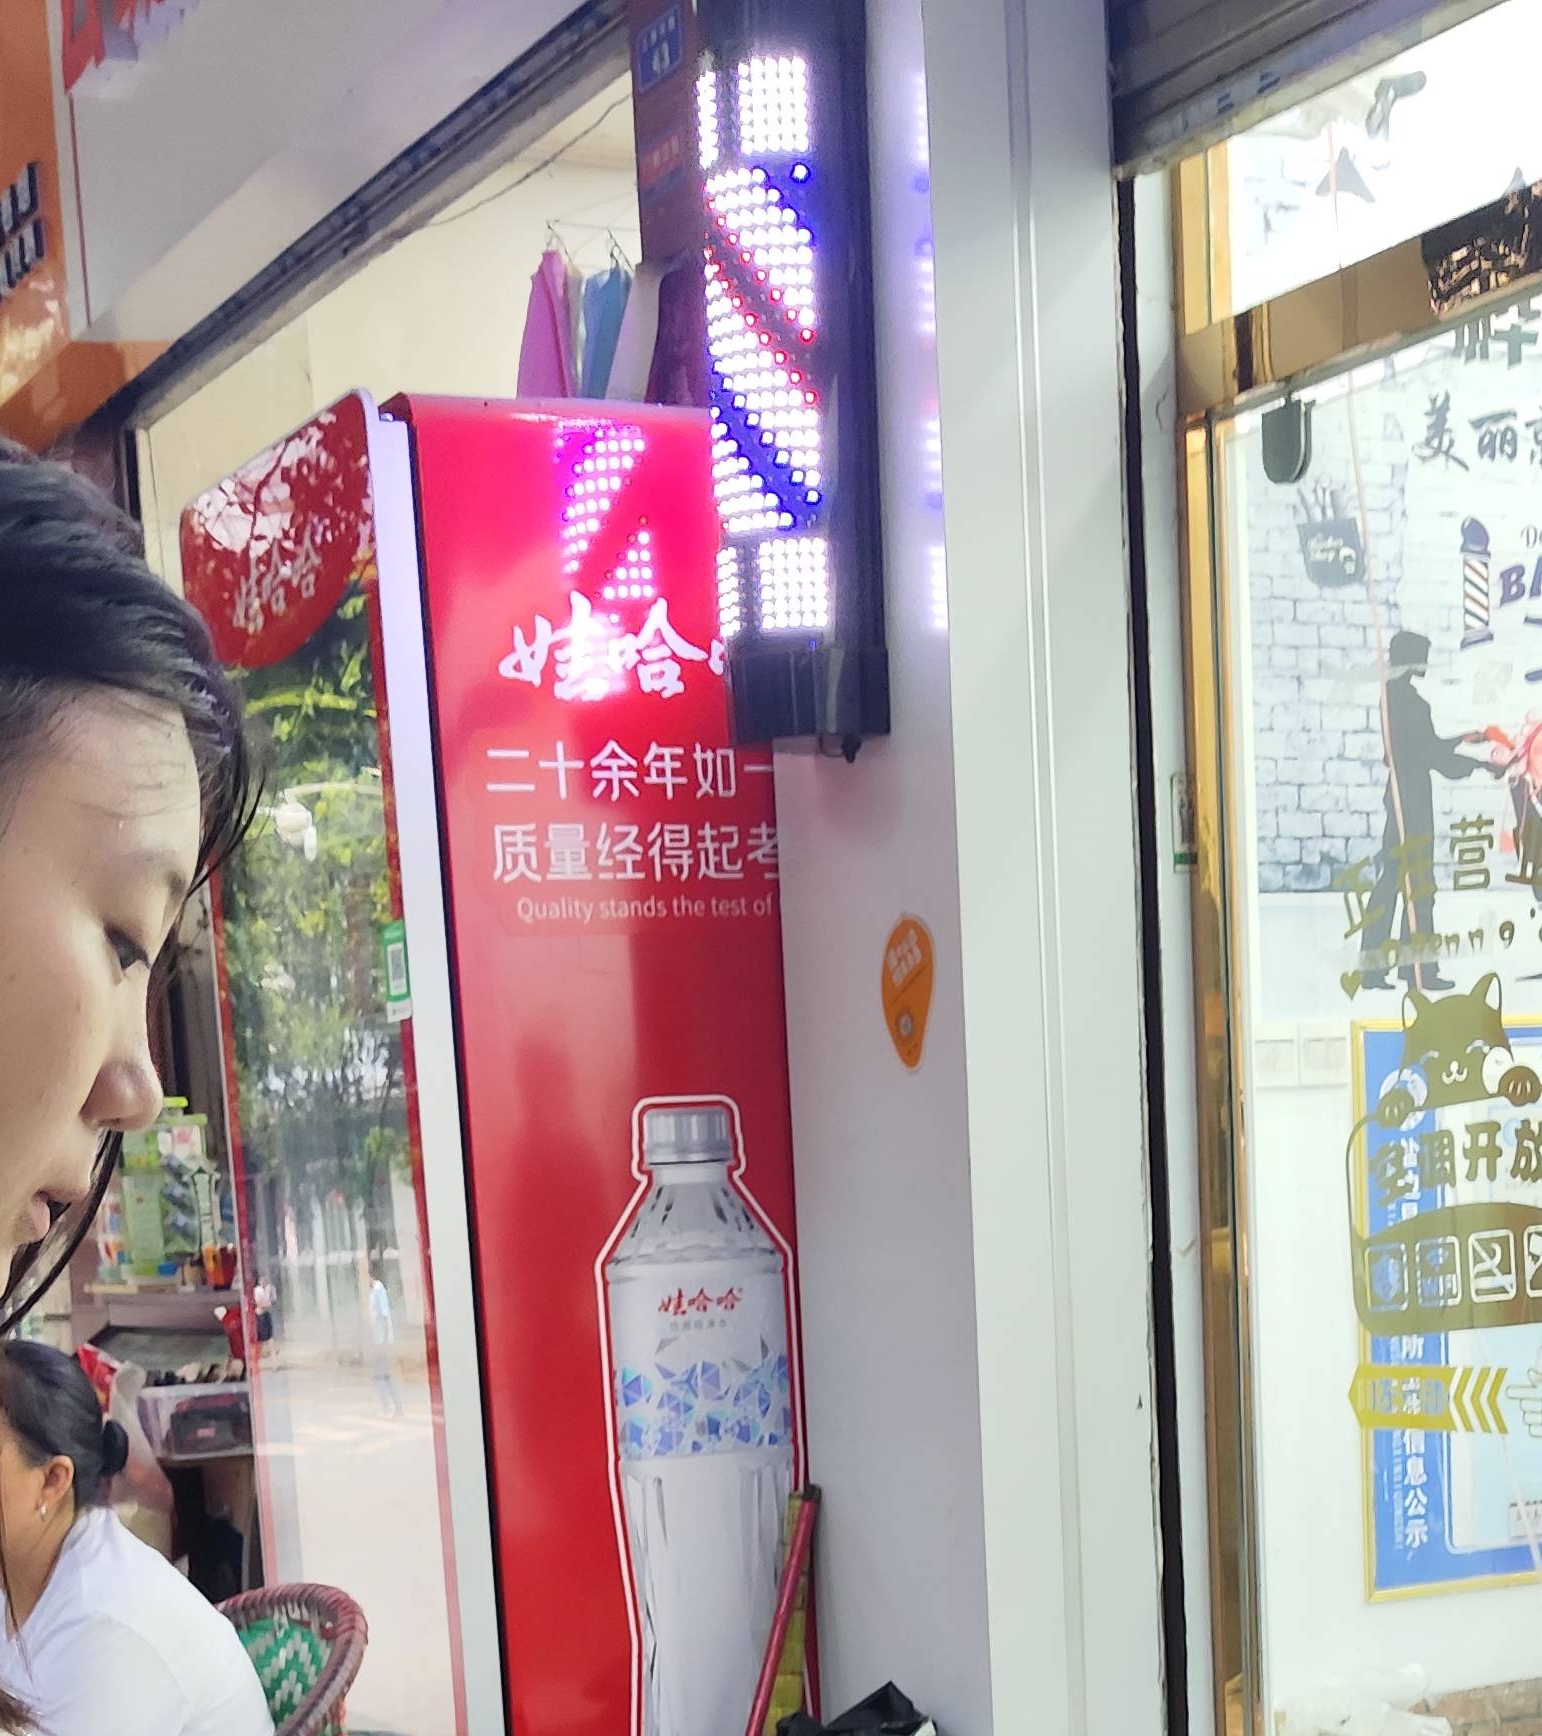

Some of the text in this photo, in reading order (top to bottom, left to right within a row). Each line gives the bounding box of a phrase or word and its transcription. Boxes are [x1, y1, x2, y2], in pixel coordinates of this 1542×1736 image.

[498, 589, 726, 701] 娃哈
[516, 894, 773, 924] Quality stands the test of
[657, 1287, 743, 1317] 娃哈哈
